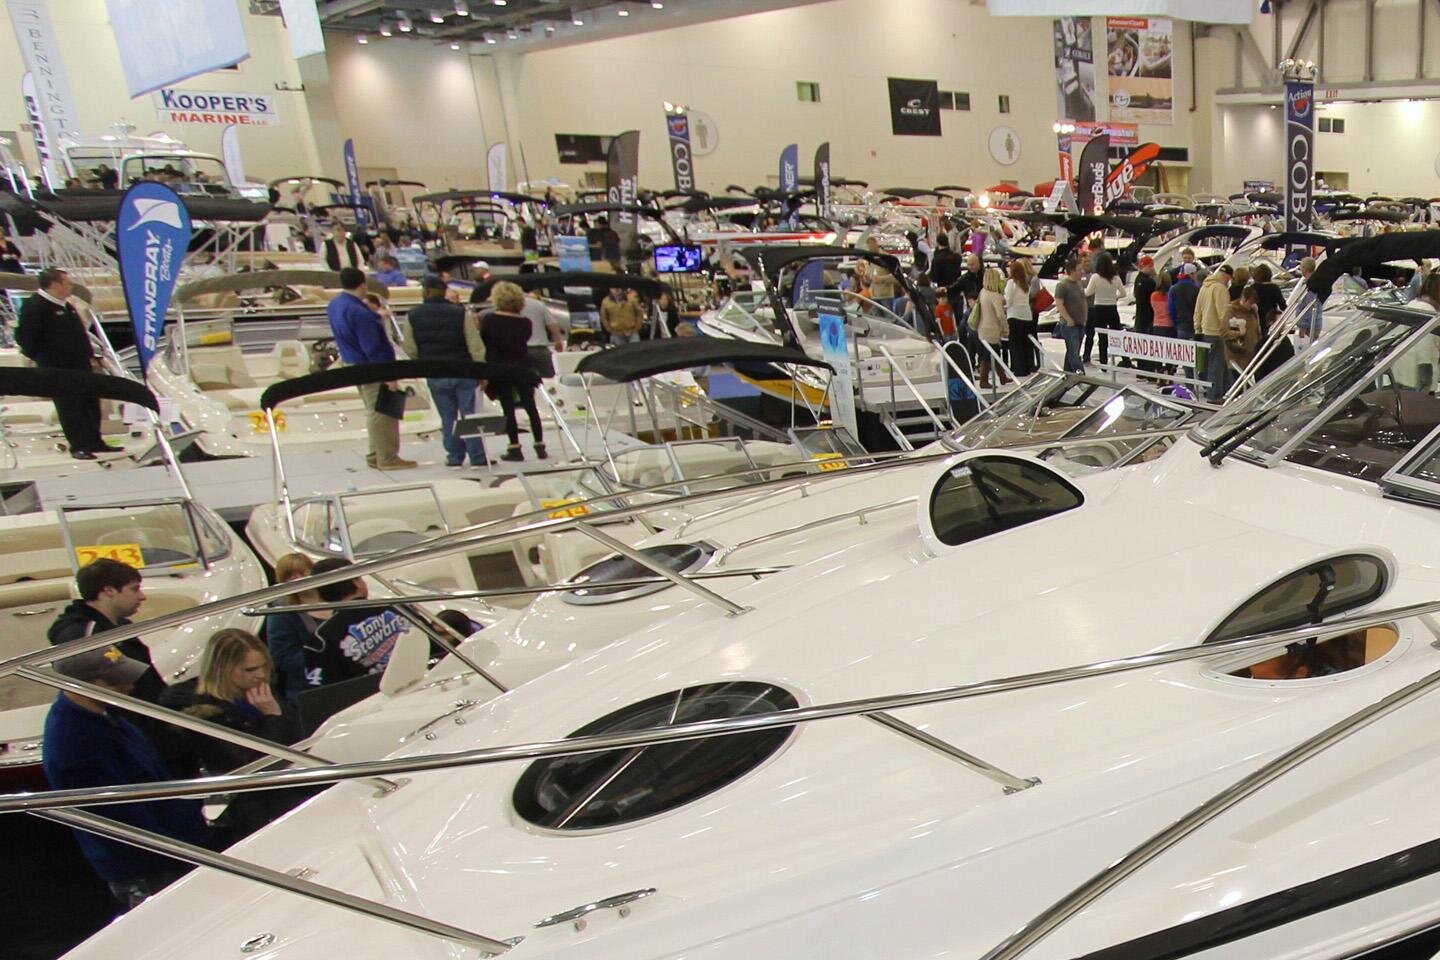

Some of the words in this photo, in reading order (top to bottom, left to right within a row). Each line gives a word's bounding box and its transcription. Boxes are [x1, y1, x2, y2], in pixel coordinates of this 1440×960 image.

[161, 89, 268, 112] KOOPER'S
[900, 107, 930, 116] CREST
[171, 113, 250, 126] MARINE
[674, 143, 692, 194] COB
[618, 178, 633, 224] Hrris
[143, 229, 161, 352] STINGRAY
[1123, 335, 1149, 356] GRAND
[1149, 340, 1165, 358] BAY
[1166, 342, 1195, 363] MARINE
[356, 612, 386, 639] Tony
